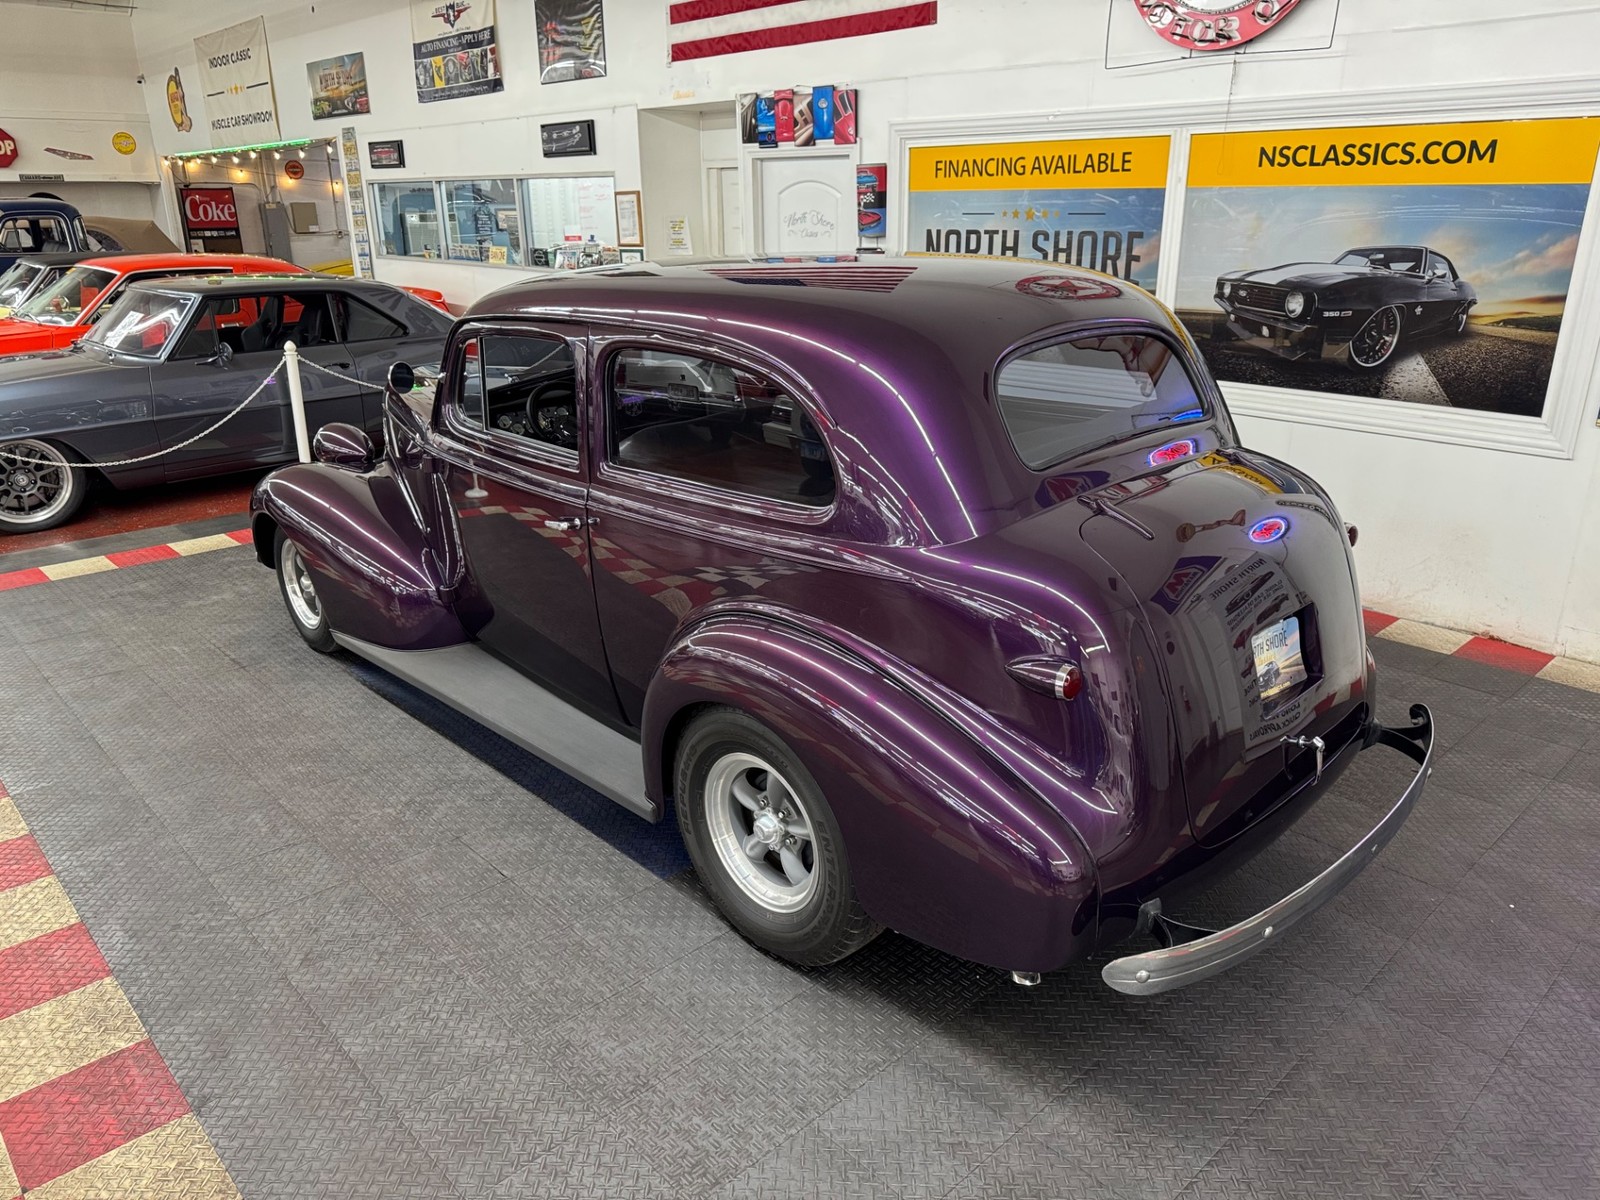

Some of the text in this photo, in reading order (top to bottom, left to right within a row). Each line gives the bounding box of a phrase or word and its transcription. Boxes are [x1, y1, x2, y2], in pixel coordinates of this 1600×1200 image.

[208, 47, 252, 69] INDOOR CLASSIC
[211, 110, 274, 131] MUSCLE CAR SHOWROOM
[0, 139, 15, 156] OP
[1257, 138, 1498, 168] NSCLASSICS.COM
[934, 151, 1133, 178] FINANCING AVAILABLE
[184, 195, 237, 222] Coke
[1265, 630, 1289, 652] SHORE
